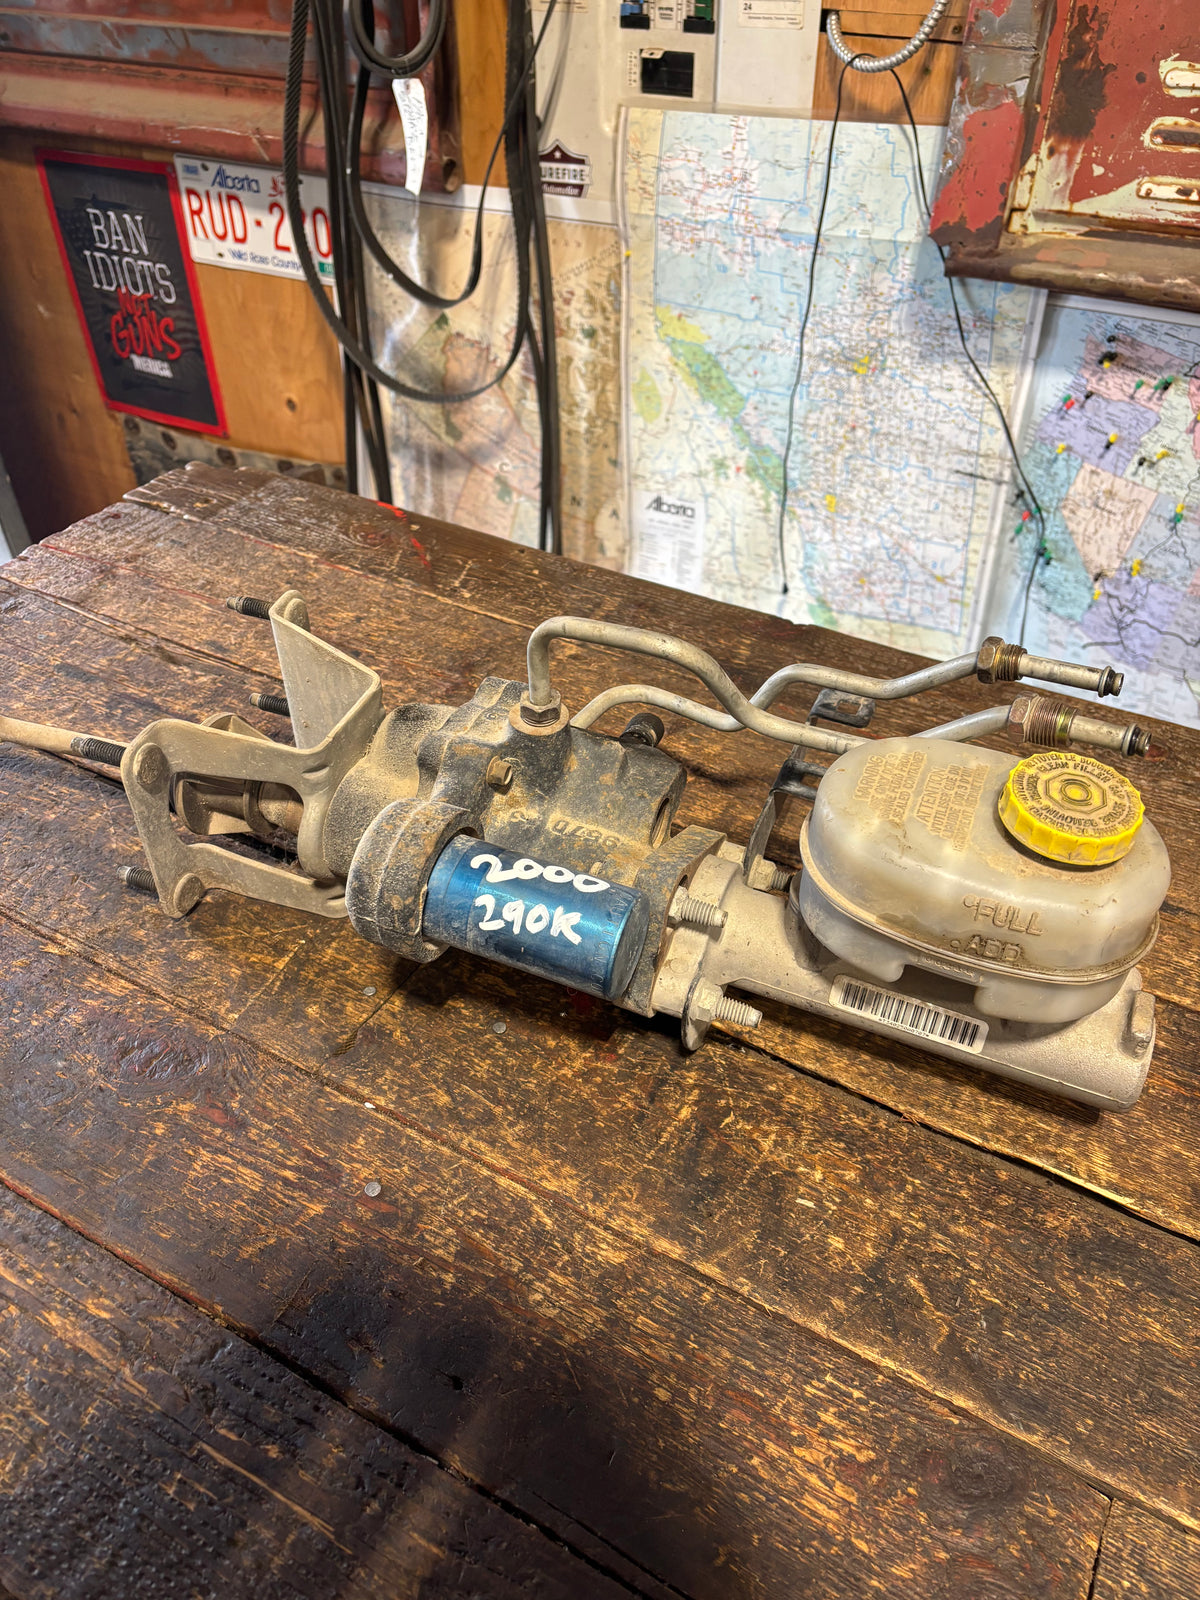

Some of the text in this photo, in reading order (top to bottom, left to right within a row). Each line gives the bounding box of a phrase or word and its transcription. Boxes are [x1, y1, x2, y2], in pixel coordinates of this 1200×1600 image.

[211, 166, 260, 193] Alberta
[86, 207, 150, 256] BAN
[185, 188, 331, 258] RUD-20
[83, 250, 177, 305] IDIOTS
[117, 287, 153, 319] NOT
[110, 313, 182, 361] GUNS
[645, 495, 696, 519] Alberta
[890, 752, 898, 761] 3
[1037, 761, 1070, 773] CLEAN
[1065, 754, 1076, 762] LE
[1073, 761, 1112, 783] FILLER
[857, 756, 882, 797] WARNING
[893, 791, 910, 818] SEALED
[917, 767, 945, 822] ATTENTION
[1040, 802, 1098, 828] REMOVING
[470, 853, 611, 893] 2000
[474, 893, 583, 946] 290K
[973, 898, 1044, 937] FULL
[964, 934, 1023, 963] ADD
